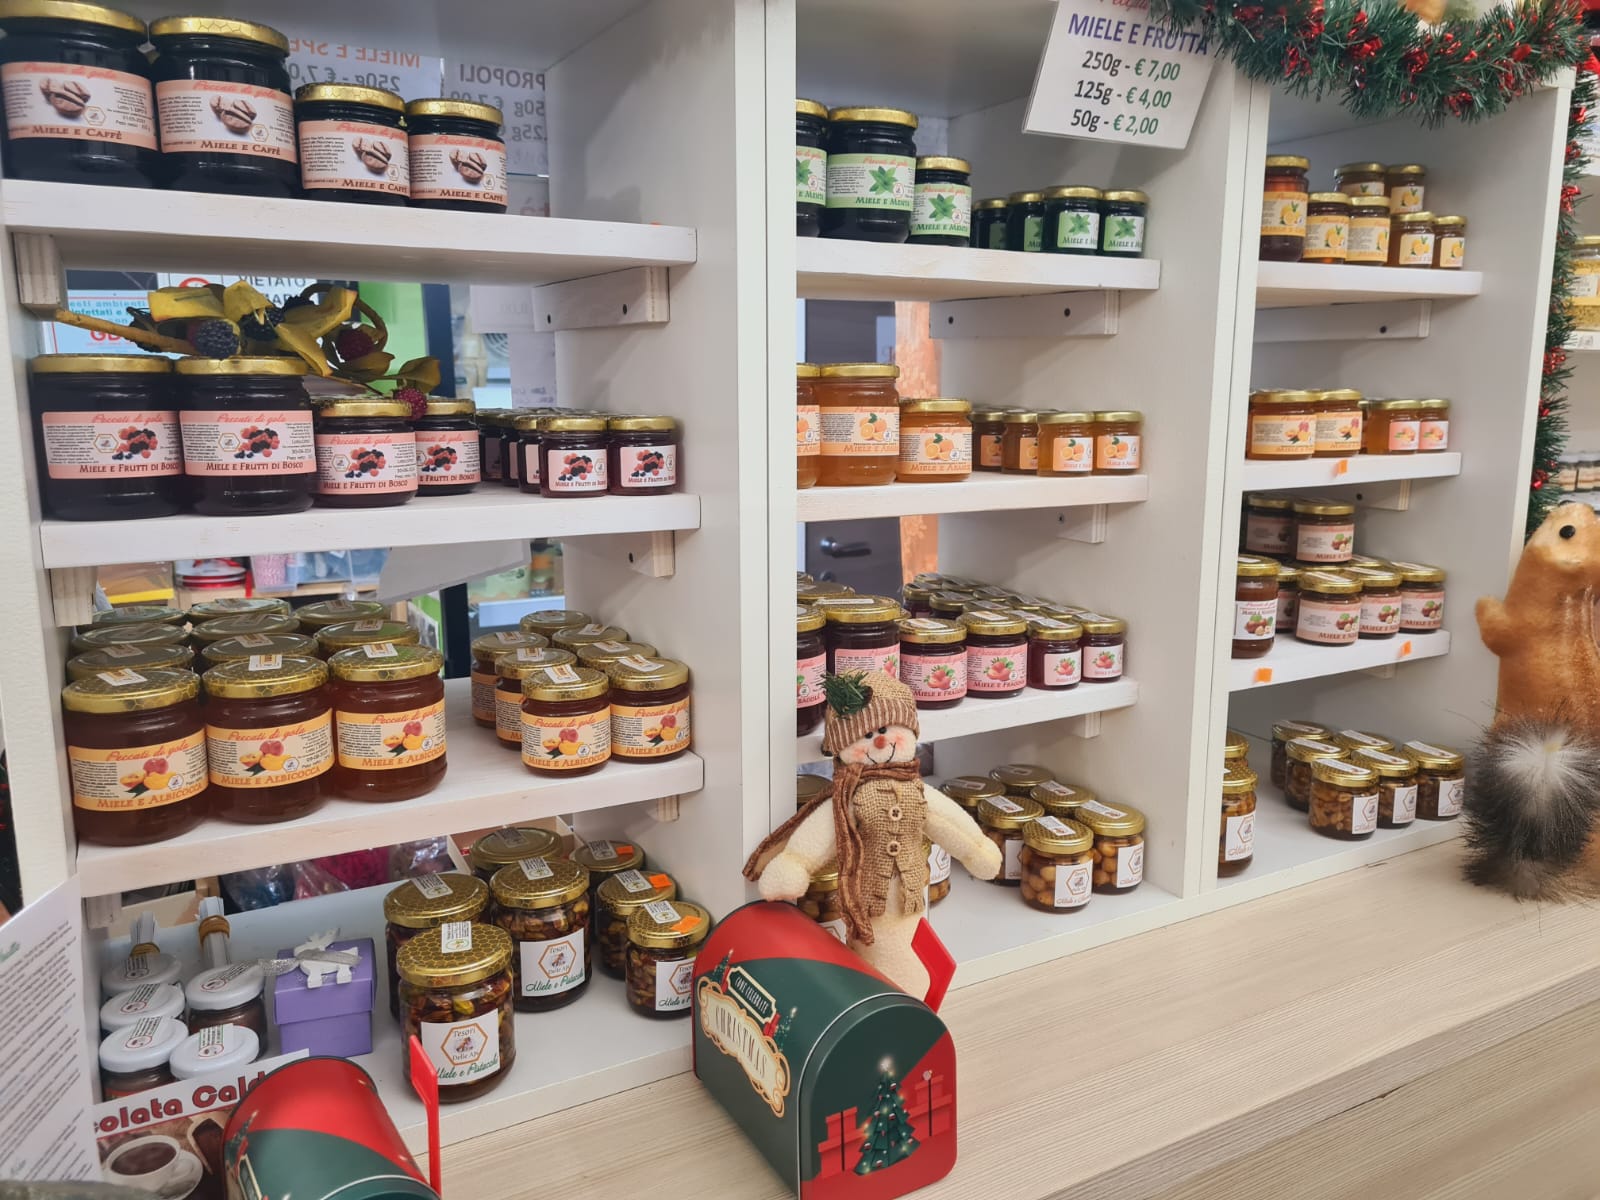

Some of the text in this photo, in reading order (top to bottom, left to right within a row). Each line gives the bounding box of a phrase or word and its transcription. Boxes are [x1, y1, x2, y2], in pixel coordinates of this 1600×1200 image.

[1067, 13, 1208, 56] MIELE E FRUTTA
[1081, 50, 1122, 77] 250g
[1135, 58, 1146, 76] €
[1148, 60, 1181, 82] 7,00
[1074, 80, 1113, 105] 125g
[1126, 86, 1137, 104] €
[1138, 88, 1172, 110] 4,00
[1070, 108, 1101, 133] 50g
[1113, 114, 1124, 131] €
[1125, 115, 1159, 136] 2,00
[32, 125, 69, 135] MIELE
[200, 140, 237, 150] MIELE
[342, 179, 376, 189] MIELE
[440, 189, 472, 198] MIELE
[80, 464, 107, 473] MIELE
[119, 464, 148, 472] FRUTTI
[206, 463, 230, 471] MIELE
[240, 462, 268, 471] FRUTTI
[350, 481, 376, 489] FRUTTI
[362, 758, 394, 767] MIELE
[221, 775, 251, 785] MIELE
[97, 799, 133, 809] MIELE
[714, 1005, 767, 1079] CHRISTMAS
